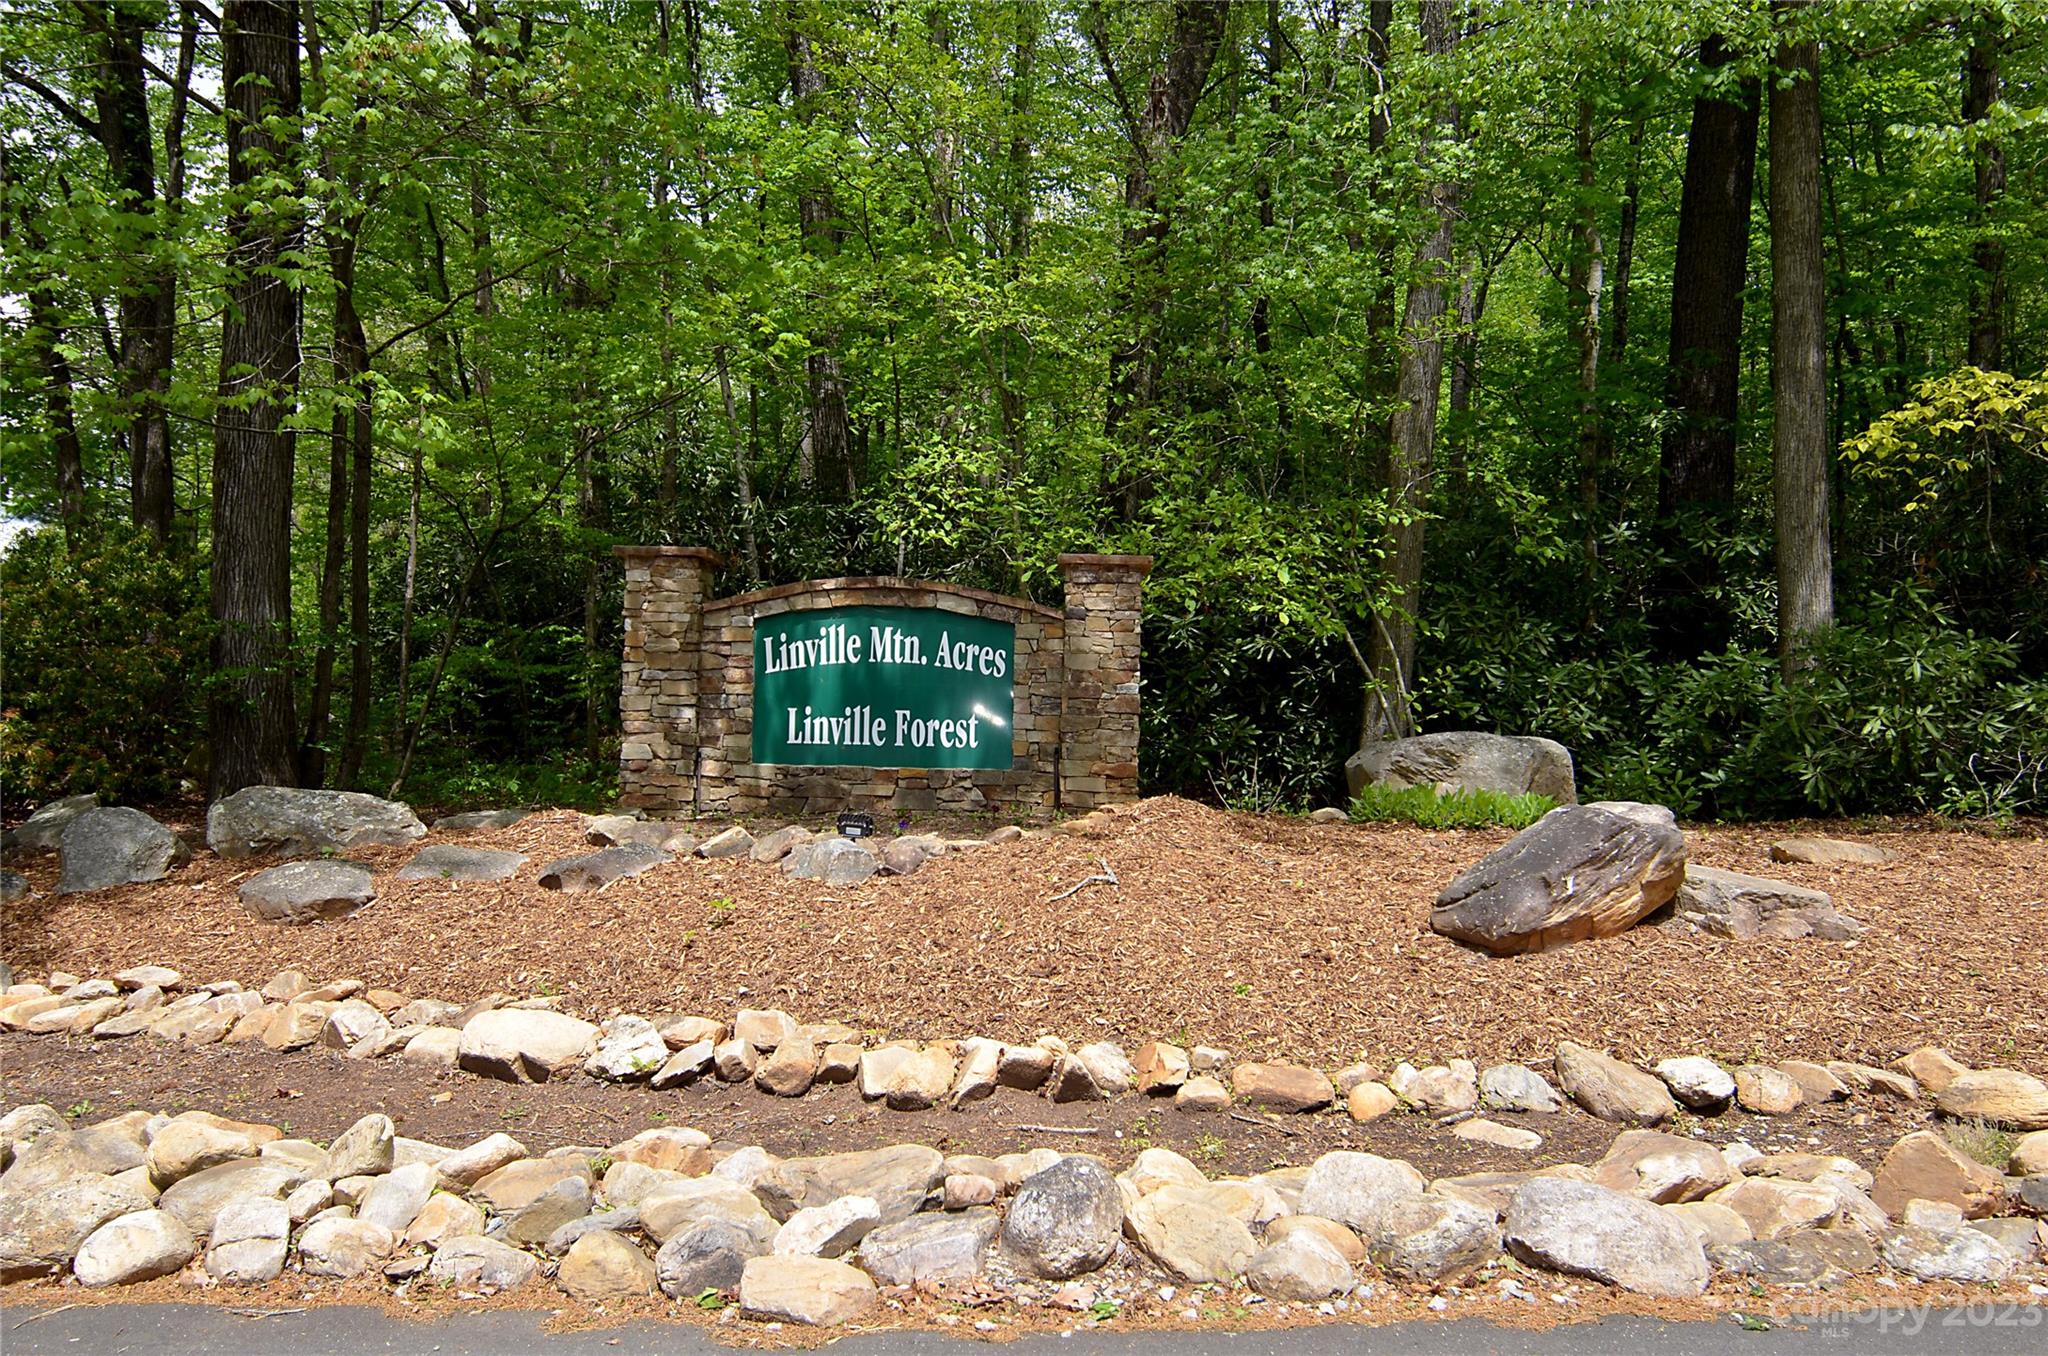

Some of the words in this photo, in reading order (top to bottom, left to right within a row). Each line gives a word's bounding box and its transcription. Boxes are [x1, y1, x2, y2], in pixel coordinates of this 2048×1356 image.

[763, 623, 862, 674] Linville
[868, 626, 928, 666] Mtn.
[934, 630, 1007, 678] Acres
[786, 704, 886, 747] Linville
[894, 709, 980, 749] Forest
